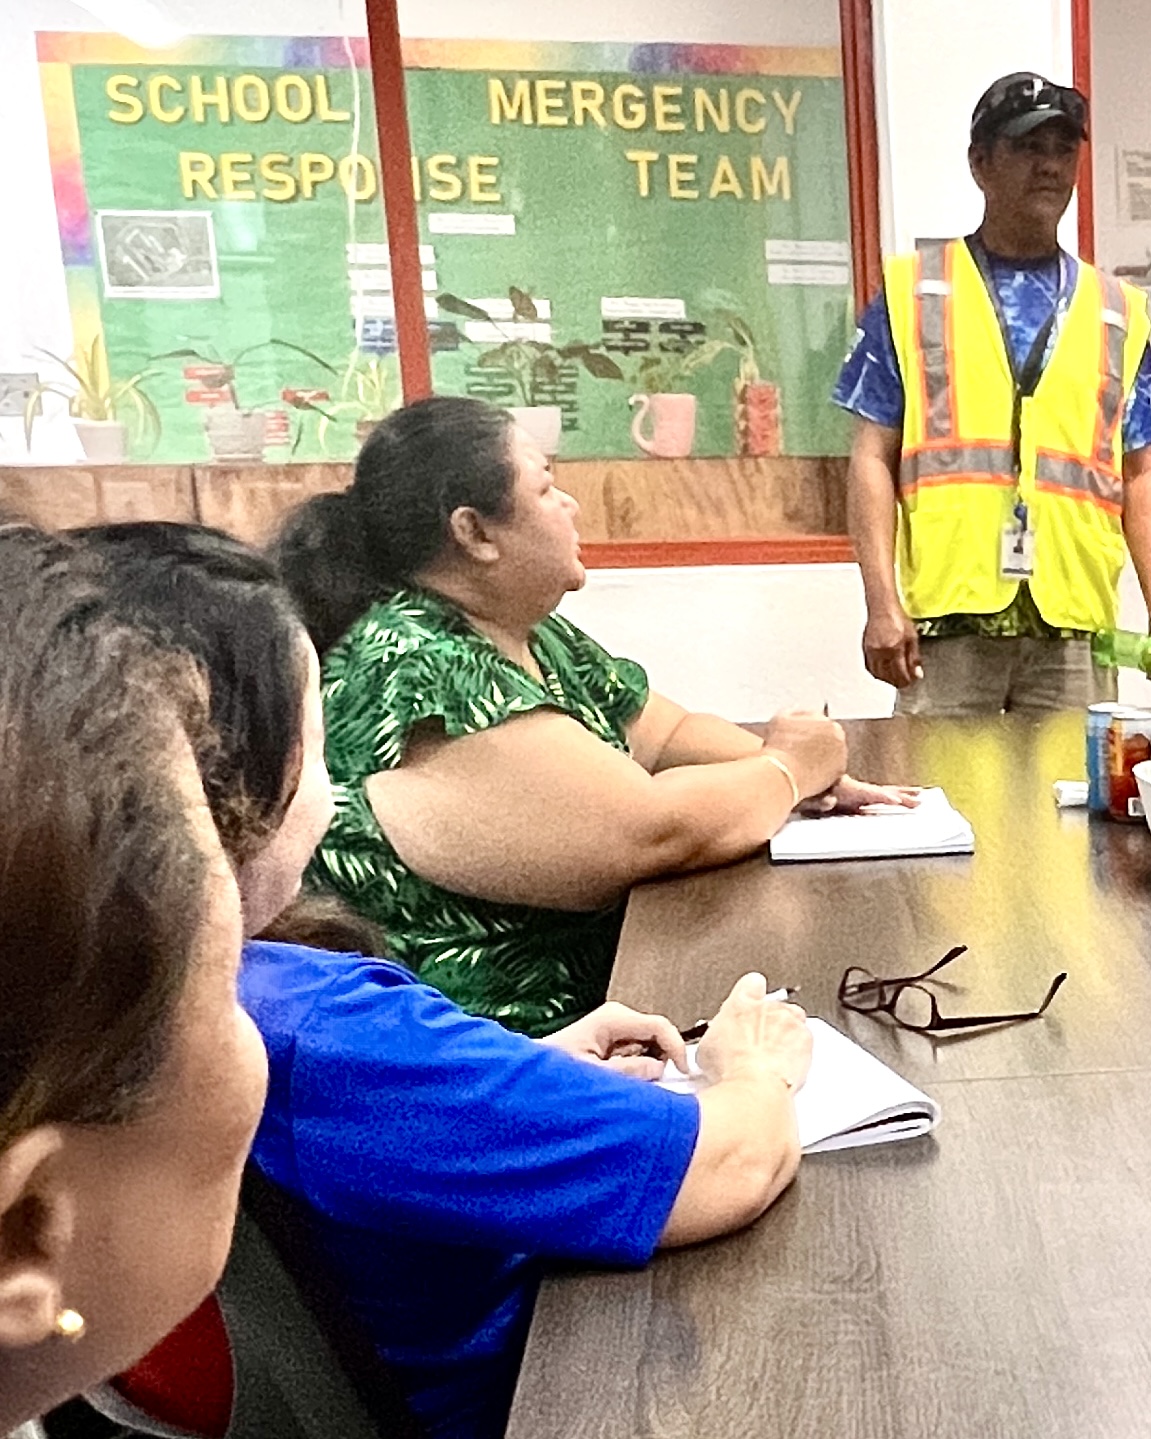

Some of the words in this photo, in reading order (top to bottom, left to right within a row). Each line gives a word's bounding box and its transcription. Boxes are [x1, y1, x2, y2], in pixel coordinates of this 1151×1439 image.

[105, 73, 350, 124] SCHOOL
[488, 79, 801, 135] MERGENCY
[179, 151, 501, 203] RESPOSE
[625, 151, 792, 201] TEAM
